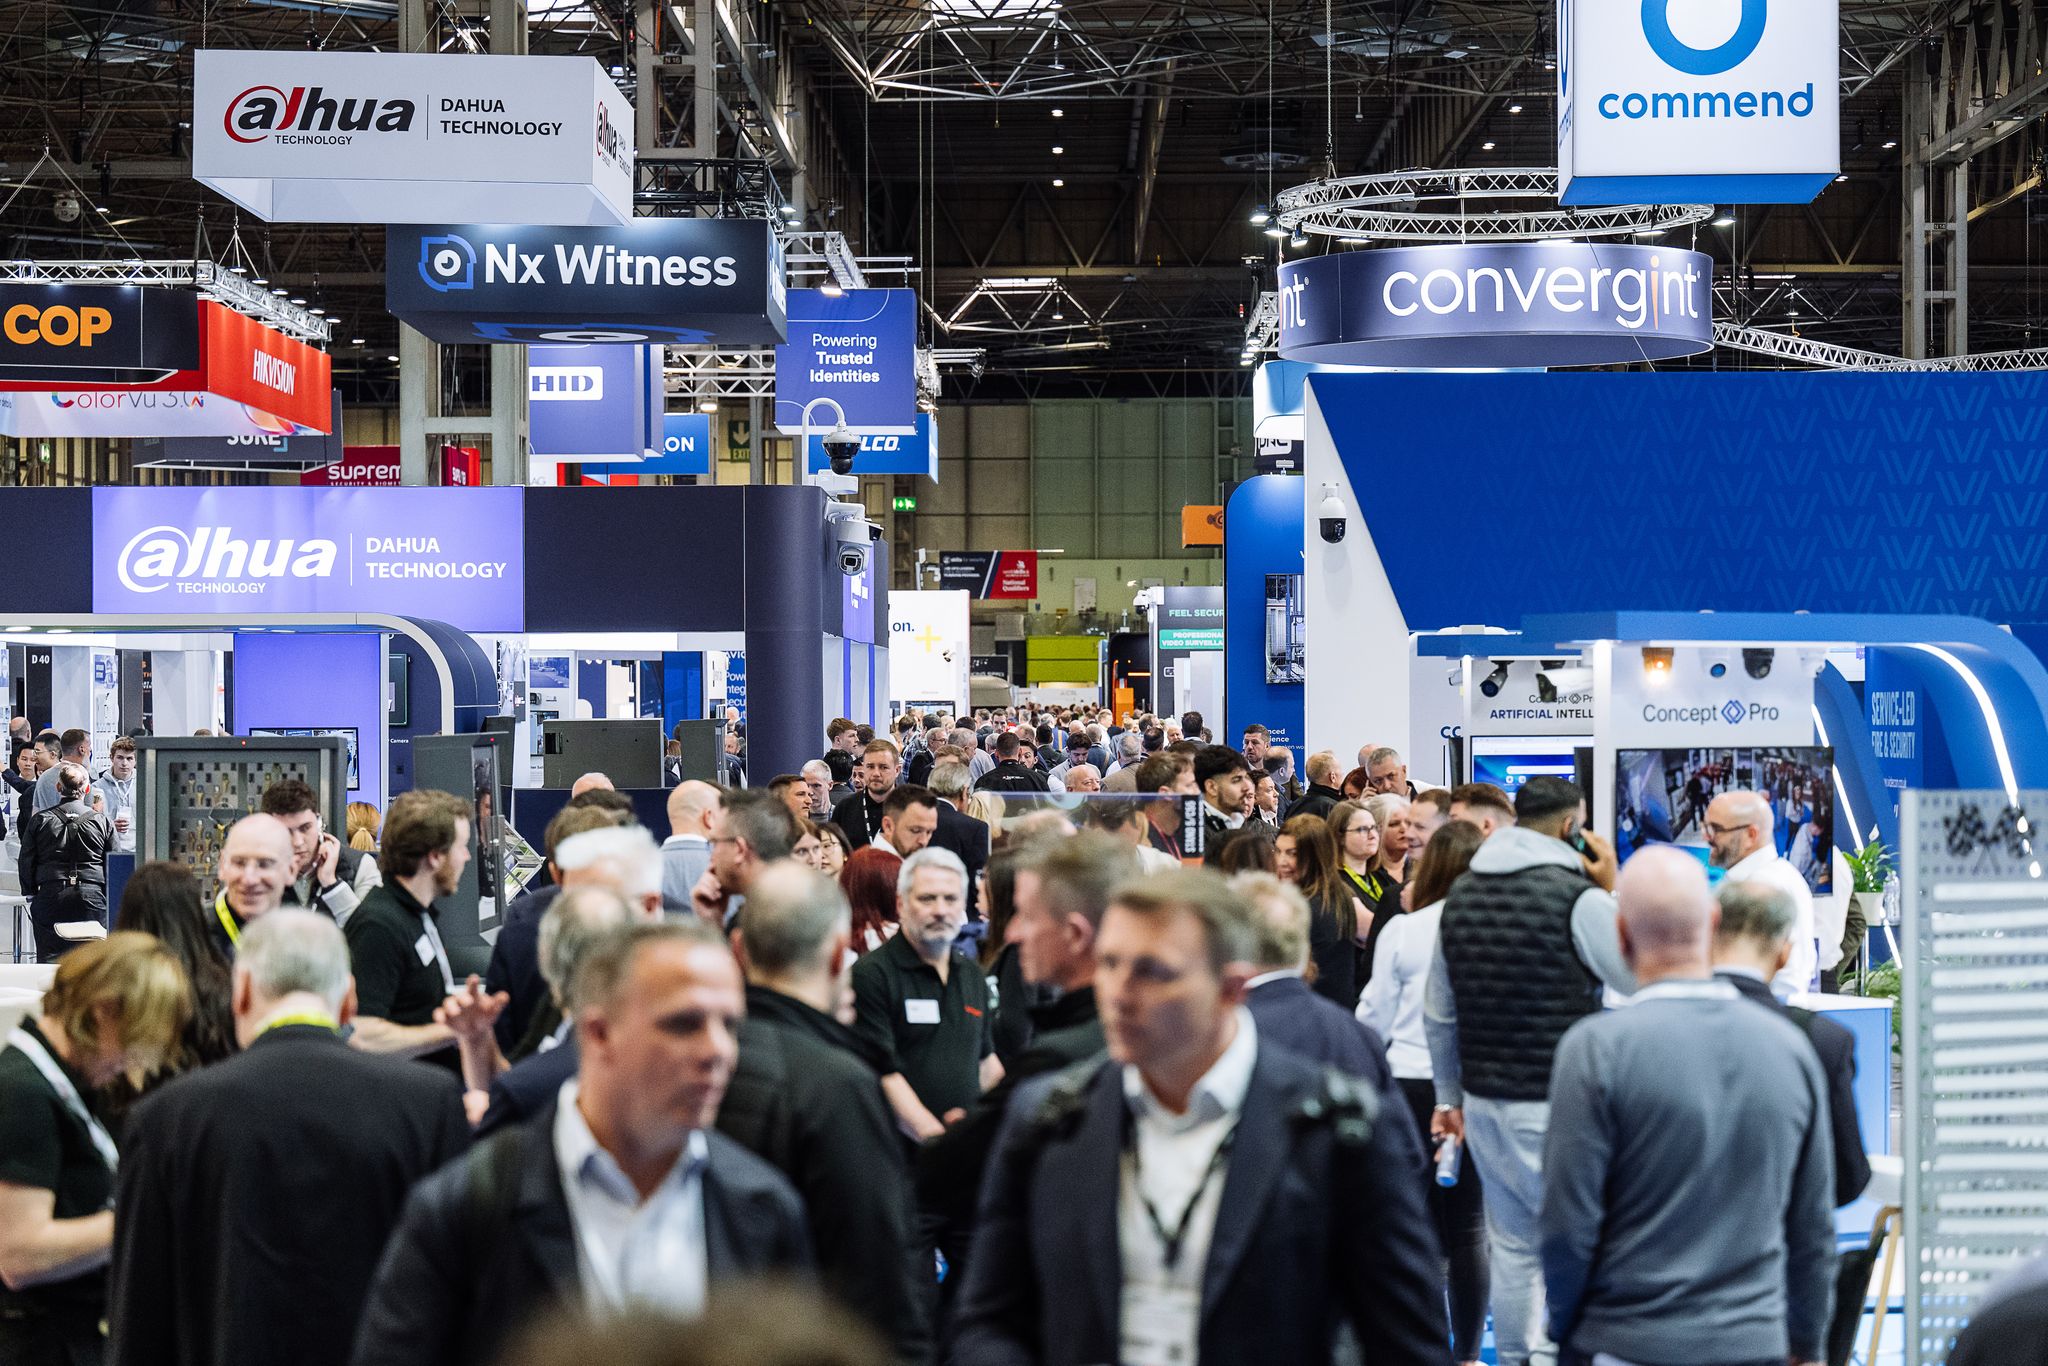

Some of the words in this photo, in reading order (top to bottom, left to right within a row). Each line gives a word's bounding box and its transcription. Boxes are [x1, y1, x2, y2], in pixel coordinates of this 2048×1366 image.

[441, 98, 505, 113] DAHUA
[1598, 83, 1813, 119] commend
[440, 120, 562, 136] TECHNOLOGY
[275, 135, 353, 145] TECHNOLOGY
[485, 244, 545, 284] Nx
[554, 244, 737, 287] Witness
[1383, 256, 1698, 330] convergint
[4, 304, 112, 347] COP
[813, 334, 877, 349] Powering
[816, 352, 873, 364] Trusted
[253, 349, 296, 396] HIKVISION
[810, 369, 880, 383] Identities
[532, 376, 593, 391] HID
[664, 437, 694, 452] ON
[328, 465, 400, 479] suprem
[366, 537, 440, 554] DAHUA
[366, 562, 507, 579] TECHNOLOGY
[176, 582, 266, 594] TECHNOLOGY
[1169, 609, 1192, 617] FEEL
[892, 620, 915, 633] on.
[31, 655, 38, 664] D
[39, 655, 50, 664] 40
[1490, 709, 1553, 719] ARTIFICIAL
[1556, 708, 1594, 718] INTELL
[1643, 704, 1718, 724] Concept
[1749, 703, 1779, 721] Pro
[1871, 691, 1916, 727] SERVICE-LED
[1890, 731, 1916, 759] SECURITY
